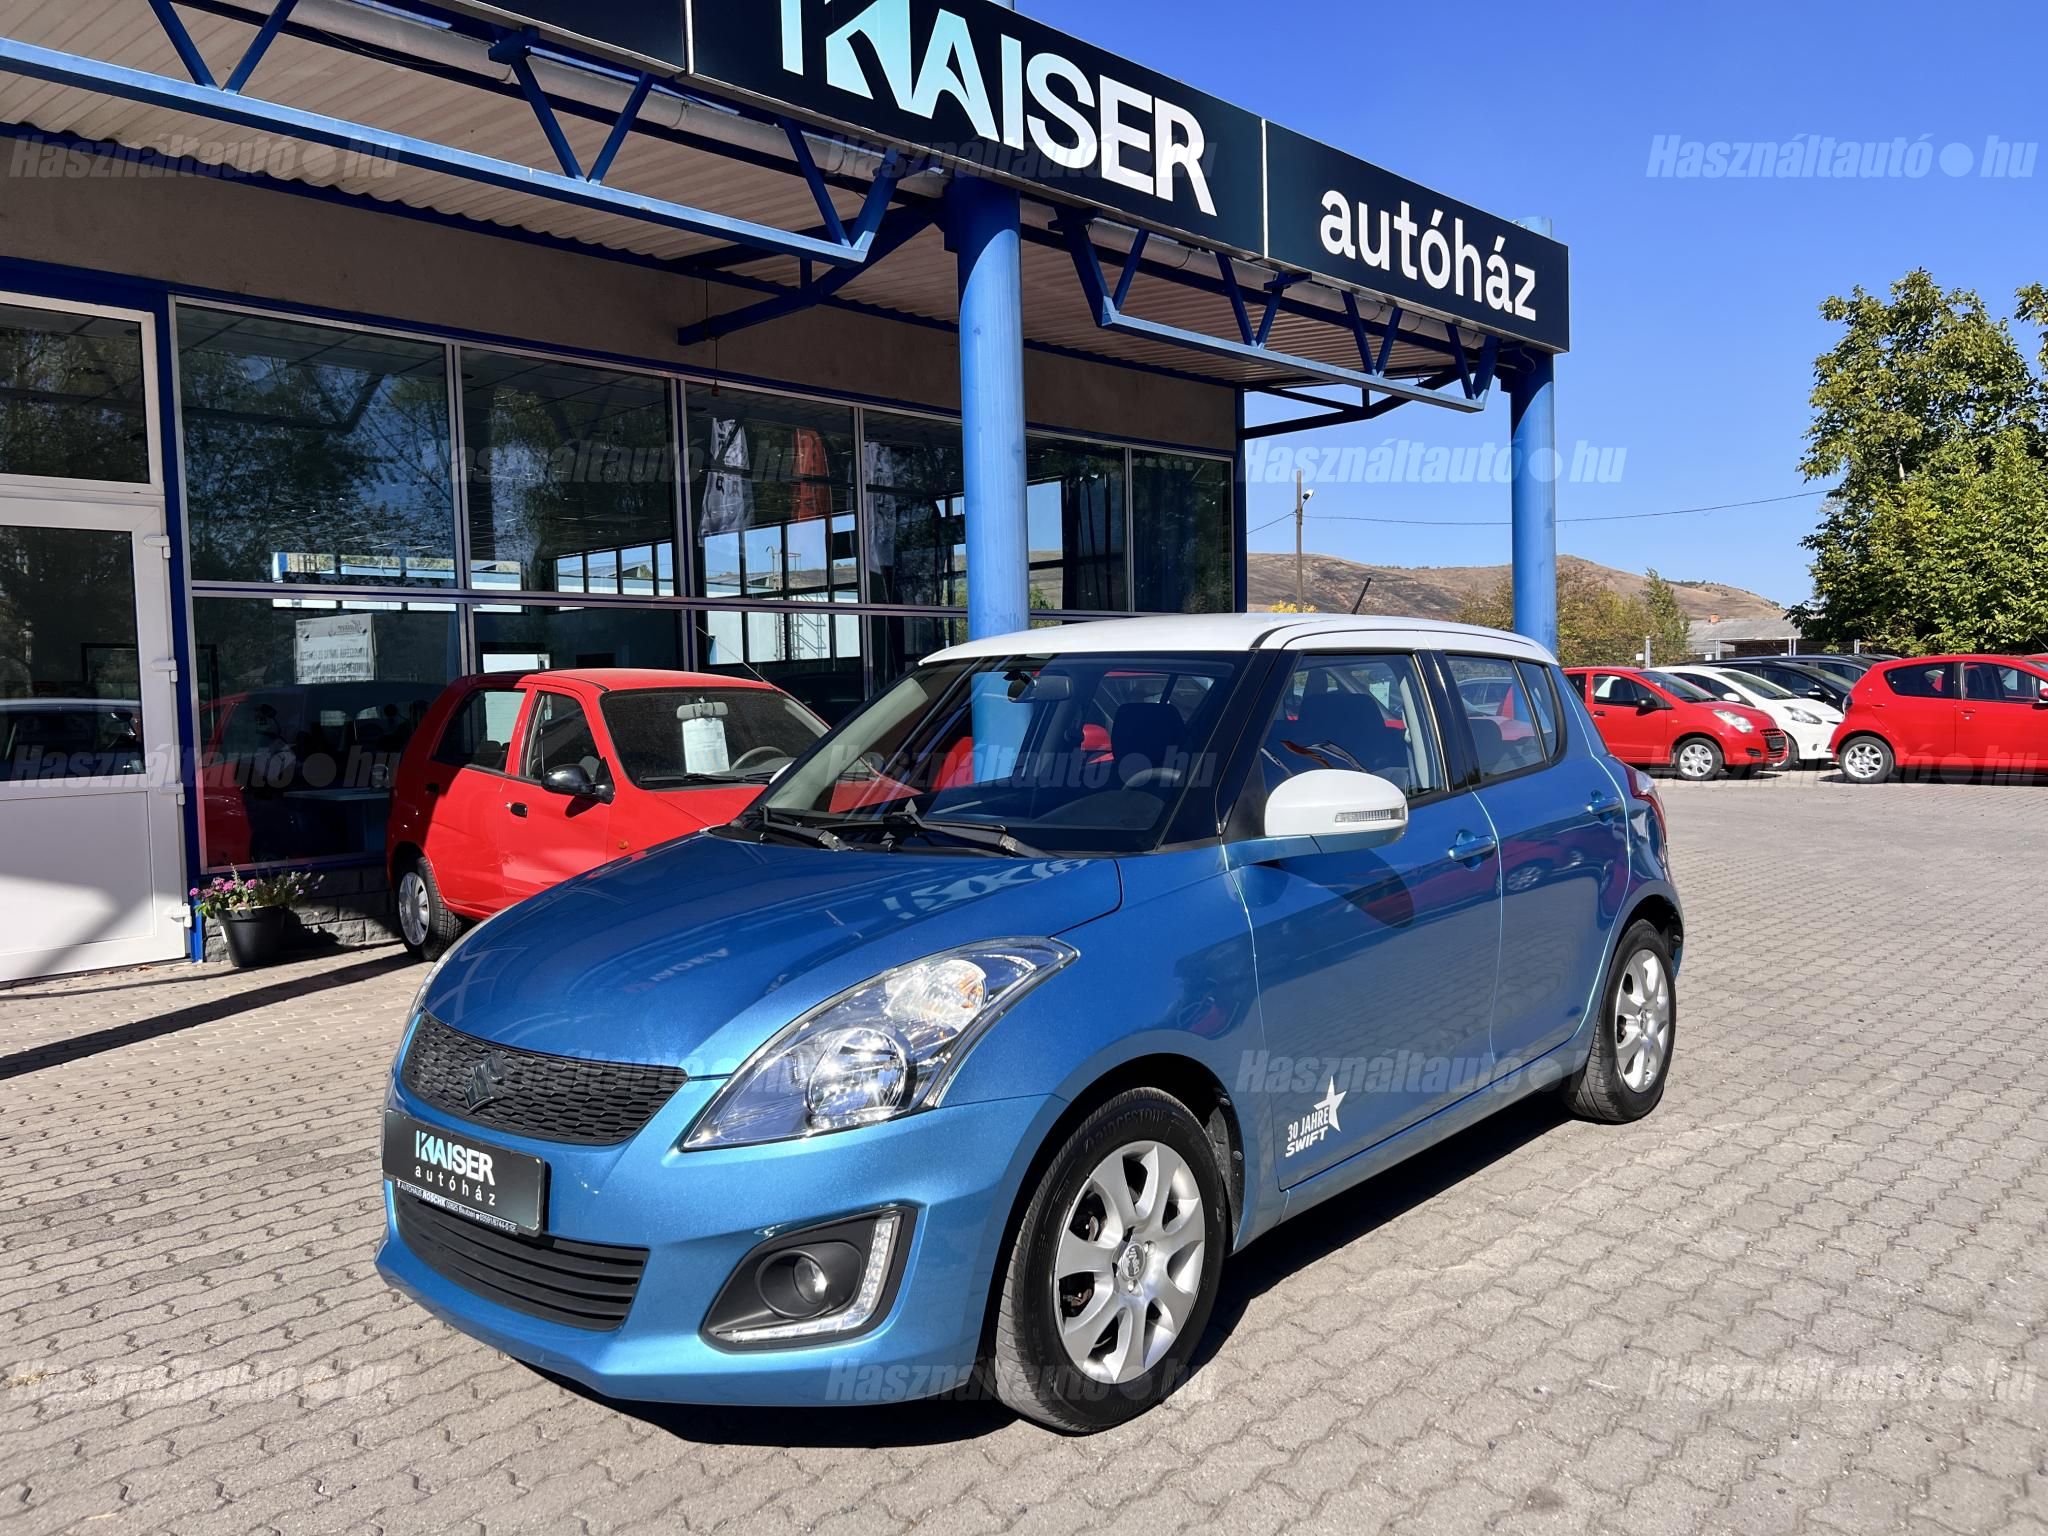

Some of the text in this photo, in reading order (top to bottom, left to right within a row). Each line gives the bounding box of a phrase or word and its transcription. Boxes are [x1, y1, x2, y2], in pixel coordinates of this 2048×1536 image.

[1320, 190, 1536, 321] autóház
[1285, 1126, 1328, 1157] SWIFT
[1288, 1107, 1329, 1142] 30 JAHRE
[415, 1129, 495, 1186] KAISER
[415, 1165, 495, 1206] autóház
